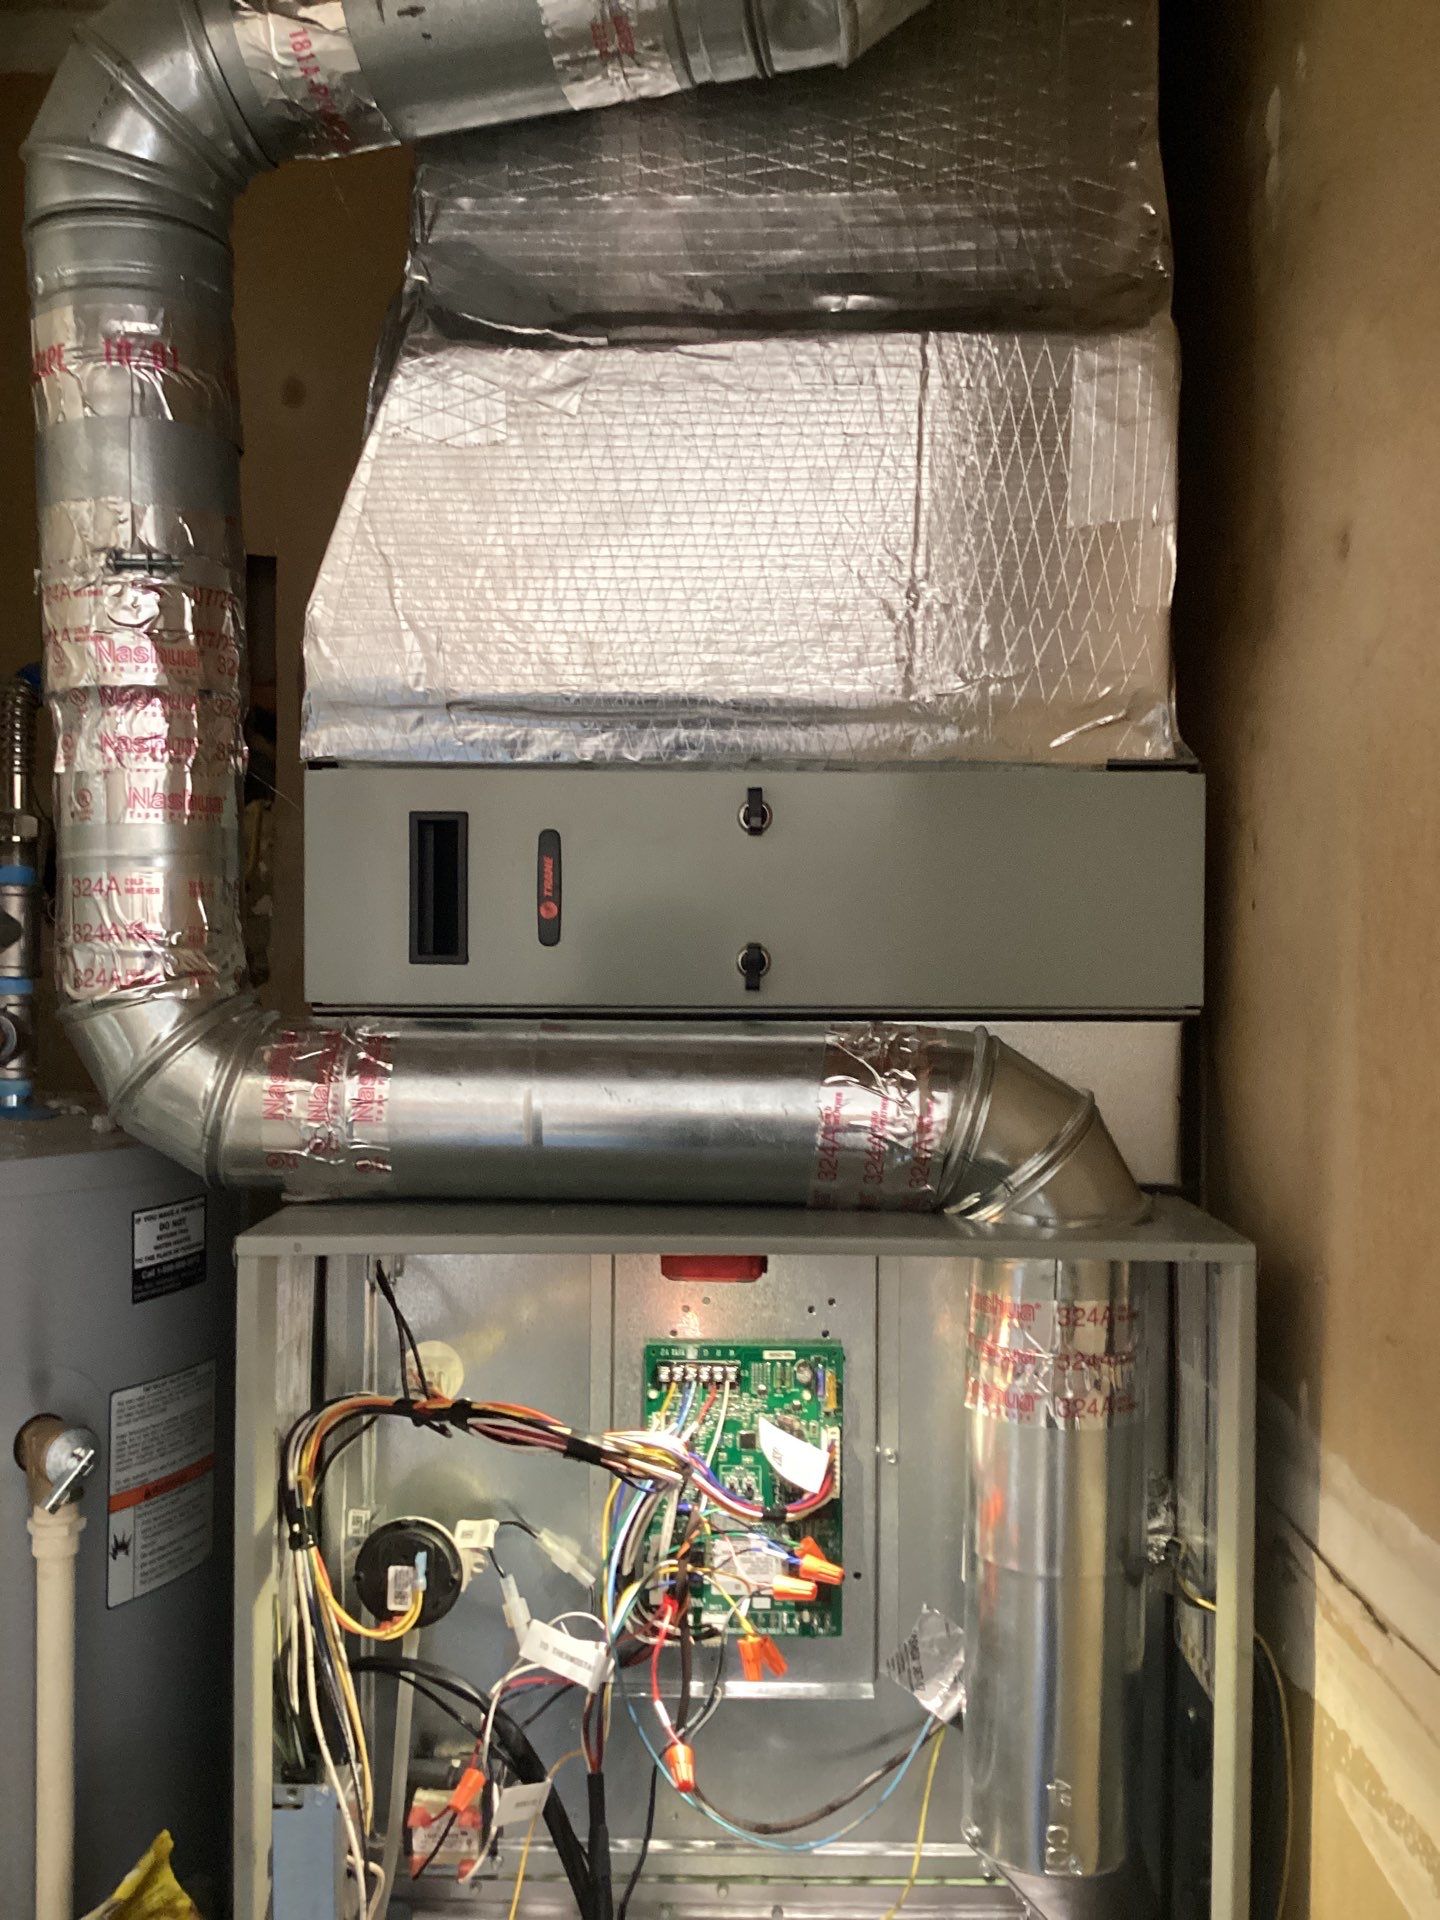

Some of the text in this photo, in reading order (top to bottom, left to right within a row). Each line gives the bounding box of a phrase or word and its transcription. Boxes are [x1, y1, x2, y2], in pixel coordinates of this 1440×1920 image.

[95, 639, 200, 668] Nashua
[128, 786, 223, 813] Nashua
[73, 875, 121, 898] 324A
[543, 855, 554, 897] TRANE
[124, 887, 161, 895] WEATHER
[73, 921, 123, 944] 324A
[818, 1129, 842, 1181] 324A
[863, 1134, 888, 1185] 324A
[909, 1139, 934, 1188] 324A
[1057, 1306, 1110, 1328] 324A
[1057, 1395, 1110, 1420] 324A
